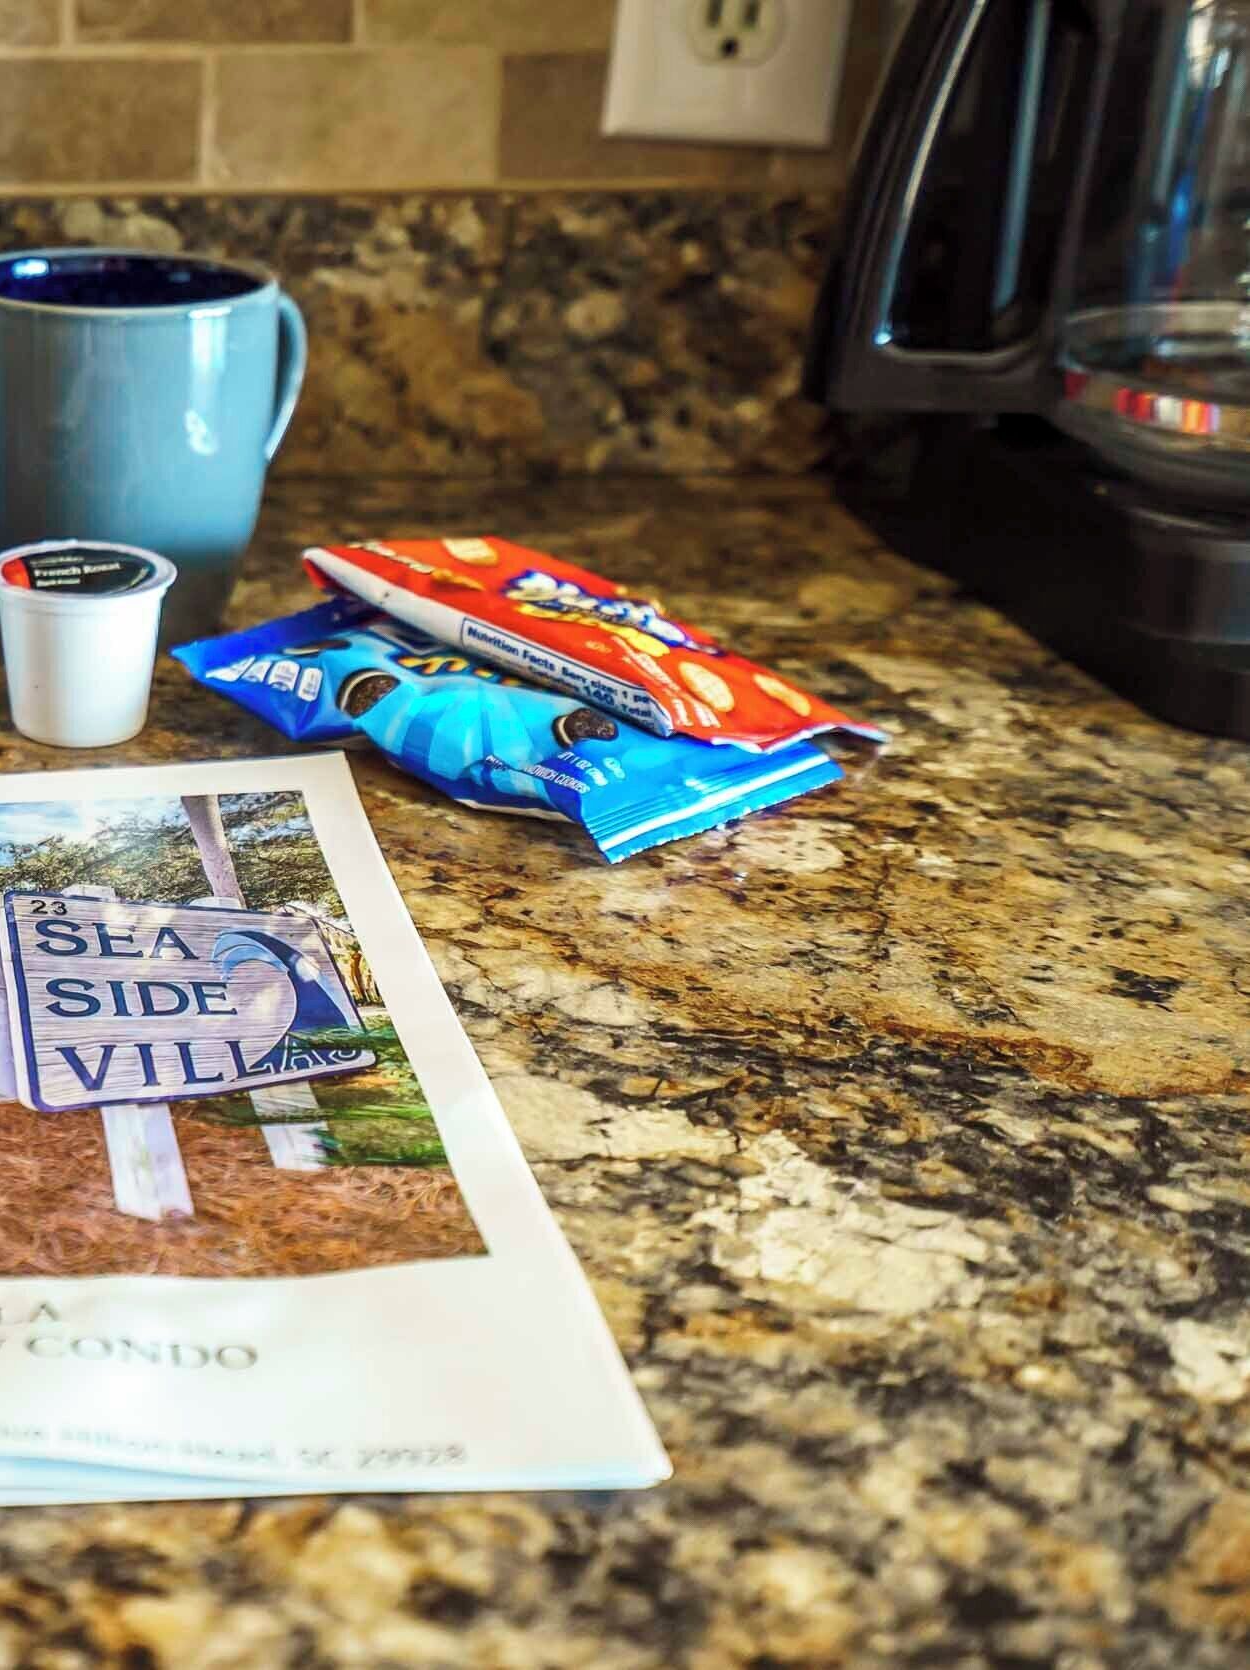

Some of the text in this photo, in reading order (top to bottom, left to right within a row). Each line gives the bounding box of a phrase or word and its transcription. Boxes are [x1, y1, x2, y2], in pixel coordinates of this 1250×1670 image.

[467, 626, 519, 656] Nutrition
[523, 650, 555, 671] Facts
[583, 685, 616, 706] 140
[554, 773, 591, 794] COOKIES
[30, 899, 68, 916] 23
[34, 919, 199, 960] SEA
[45, 978, 238, 1018] SIDE
[24, 1334, 258, 1370] CONDO
